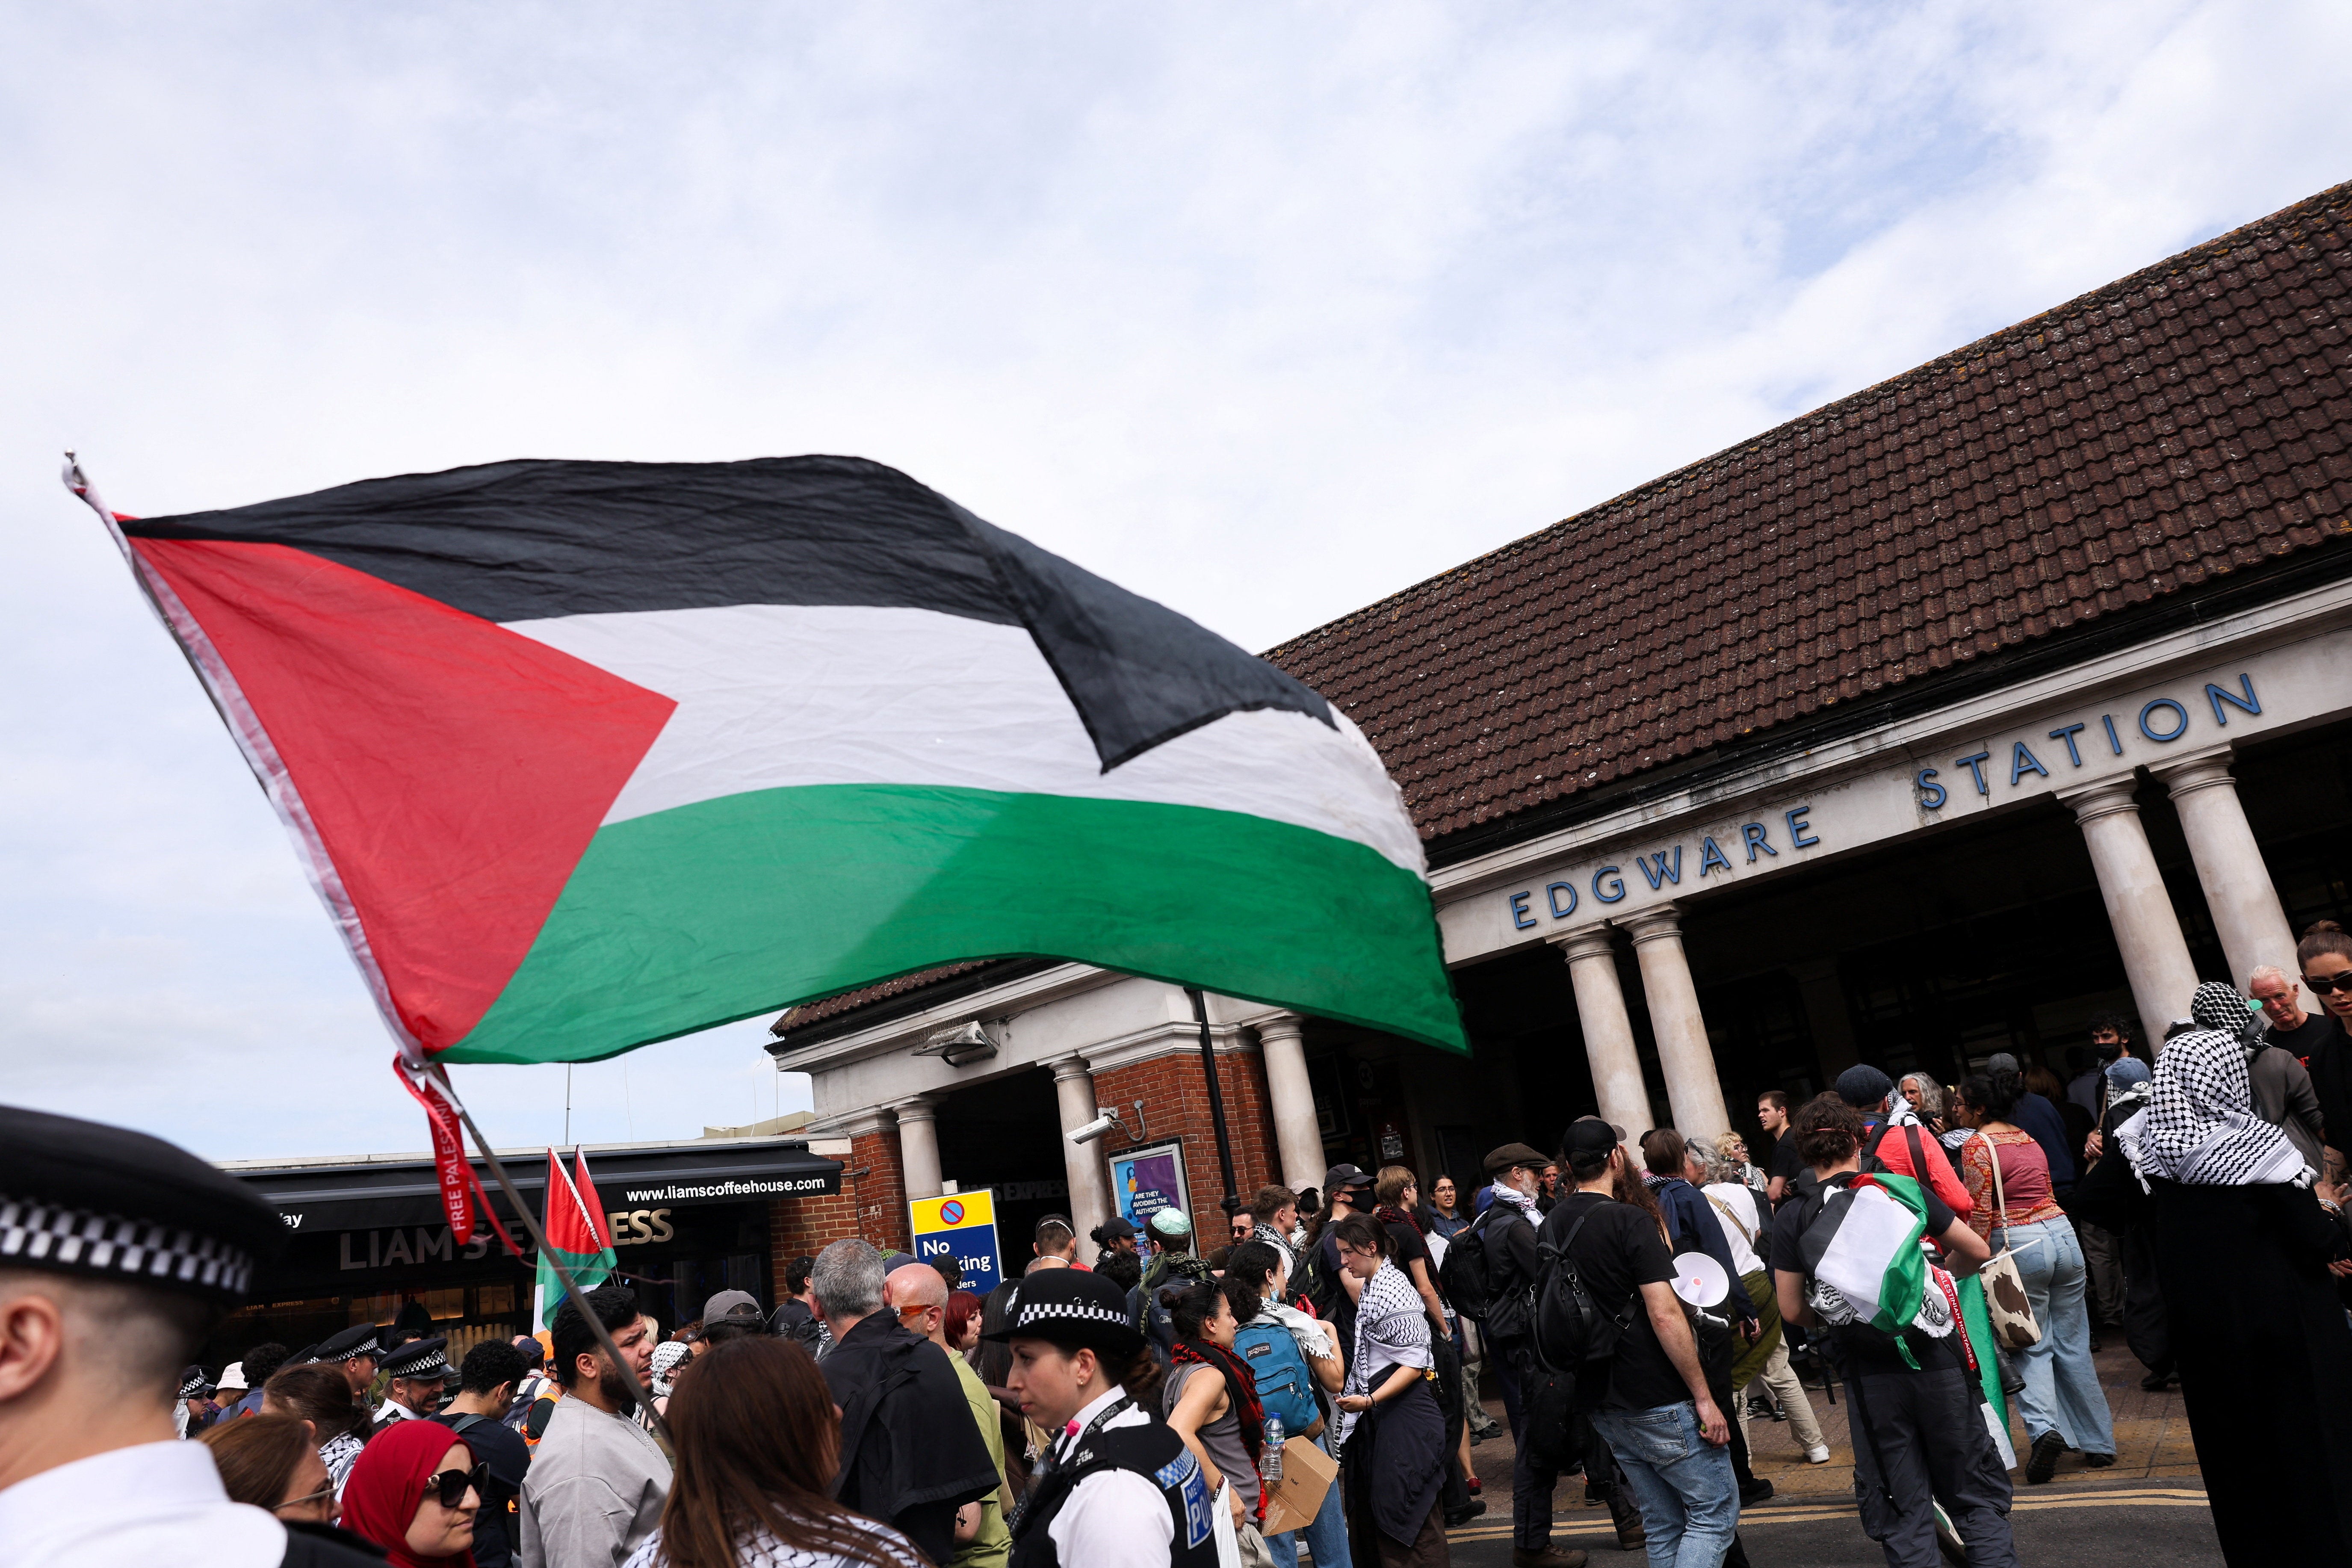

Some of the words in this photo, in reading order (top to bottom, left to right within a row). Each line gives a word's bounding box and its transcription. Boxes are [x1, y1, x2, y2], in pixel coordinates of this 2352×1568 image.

[1510, 806, 1819, 930] EDGWARE
[1917, 673, 2262, 808] STATION
[432, 1089, 460, 1185] PALESTINIA
[1383, 1135, 1400, 1143] ALARM
[627, 1177, 825, 1202] www.liamscoffeehouse.com
[448, 1189, 466, 1231] FREE
[1133, 1199, 1156, 1208] AVOIDING
[923, 1240, 950, 1256] No
[955, 1255, 991, 1272] king
[1938, 1271, 1961, 1319] PALESTINIAN
[1959, 1321, 1974, 1364] HOSTAGES
[1248, 1345, 1270, 1357] JANSPORT
[1076, 1452, 1093, 1467] 2136
